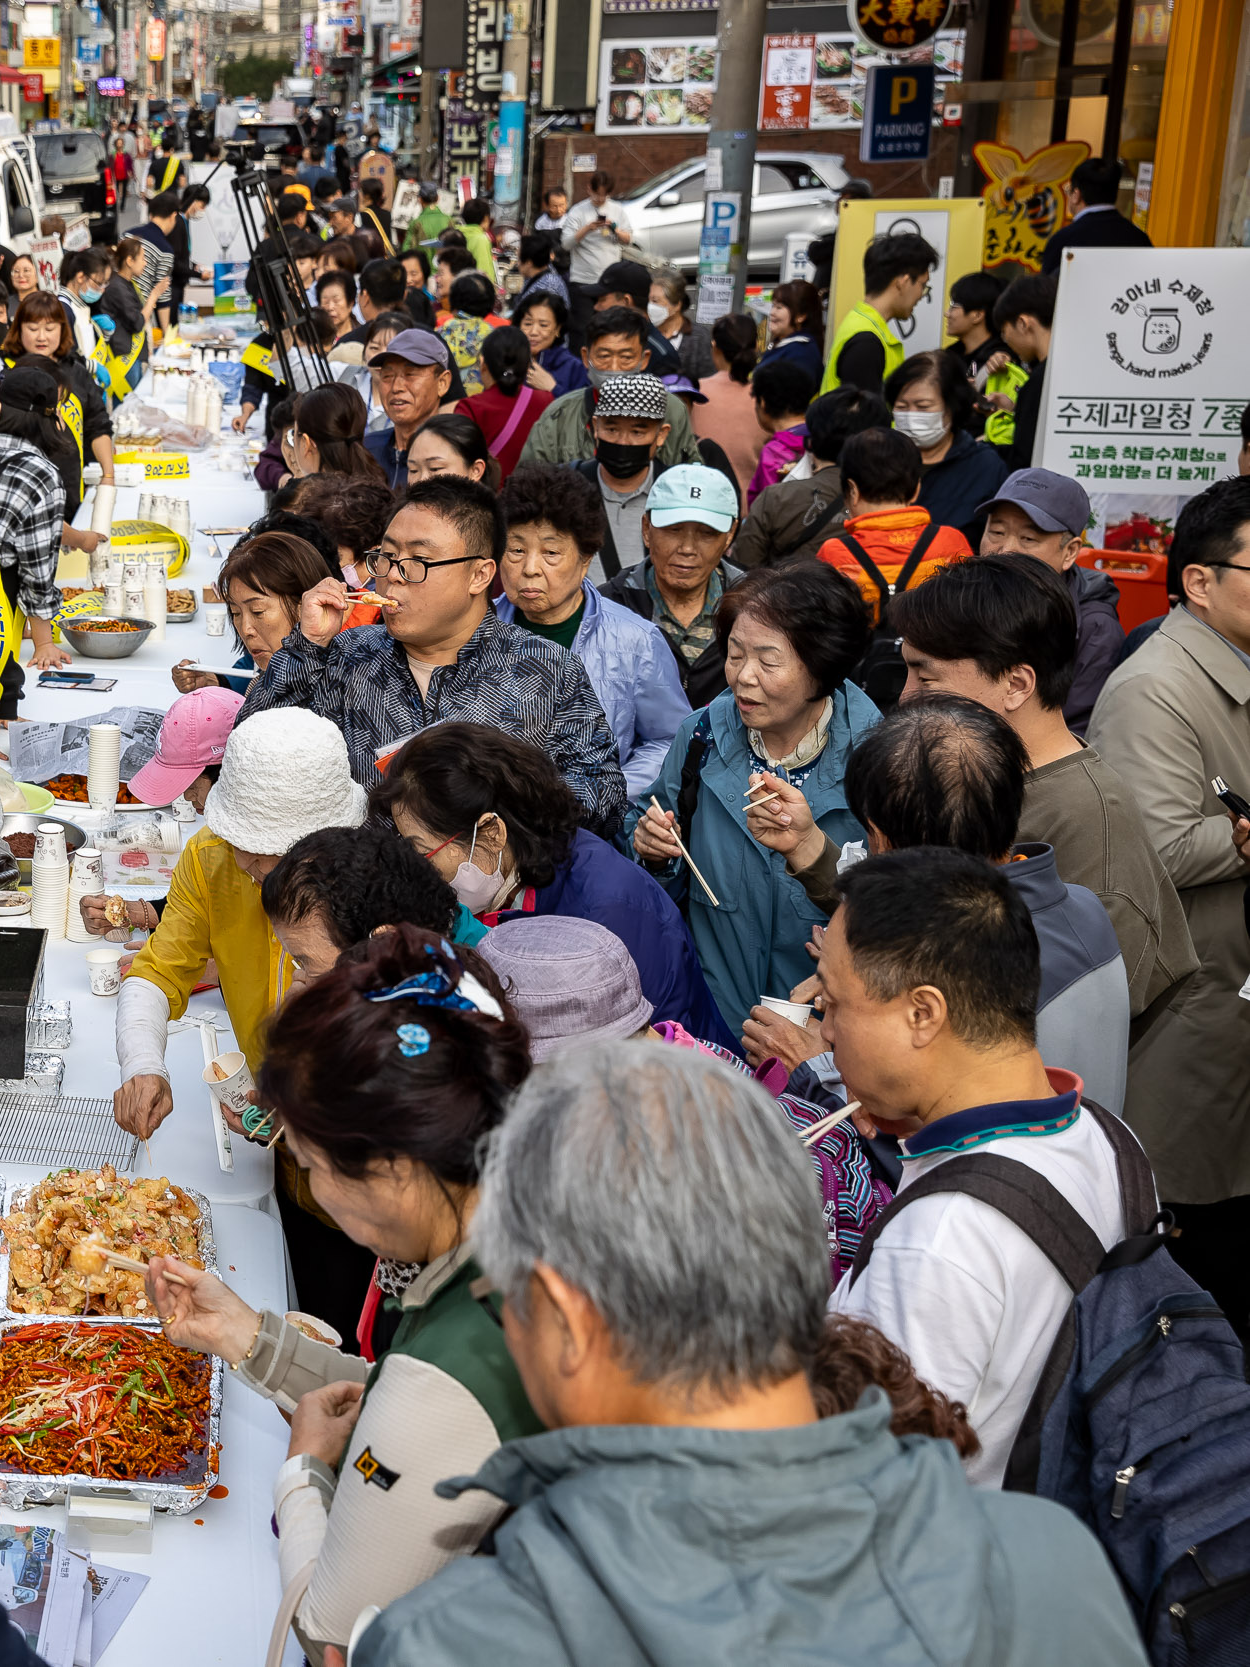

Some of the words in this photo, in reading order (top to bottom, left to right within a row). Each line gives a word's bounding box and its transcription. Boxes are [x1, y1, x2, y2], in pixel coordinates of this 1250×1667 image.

[890, 76, 917, 115] P
[875, 122, 925, 137] PARKING
[712, 202, 737, 228] P
[1168, 279, 1215, 316] 수제청
[1057, 402, 1192, 429] 수제과일청
[1203, 404, 1242, 431] 7종
[1068, 445, 1117, 461] 고농축
[1122, 446, 1227, 463] 착즙수제청으로
[1156, 467, 1172, 480] 더
[1177, 466, 1216, 481] 높게!
[691, 486, 702, 500] B
